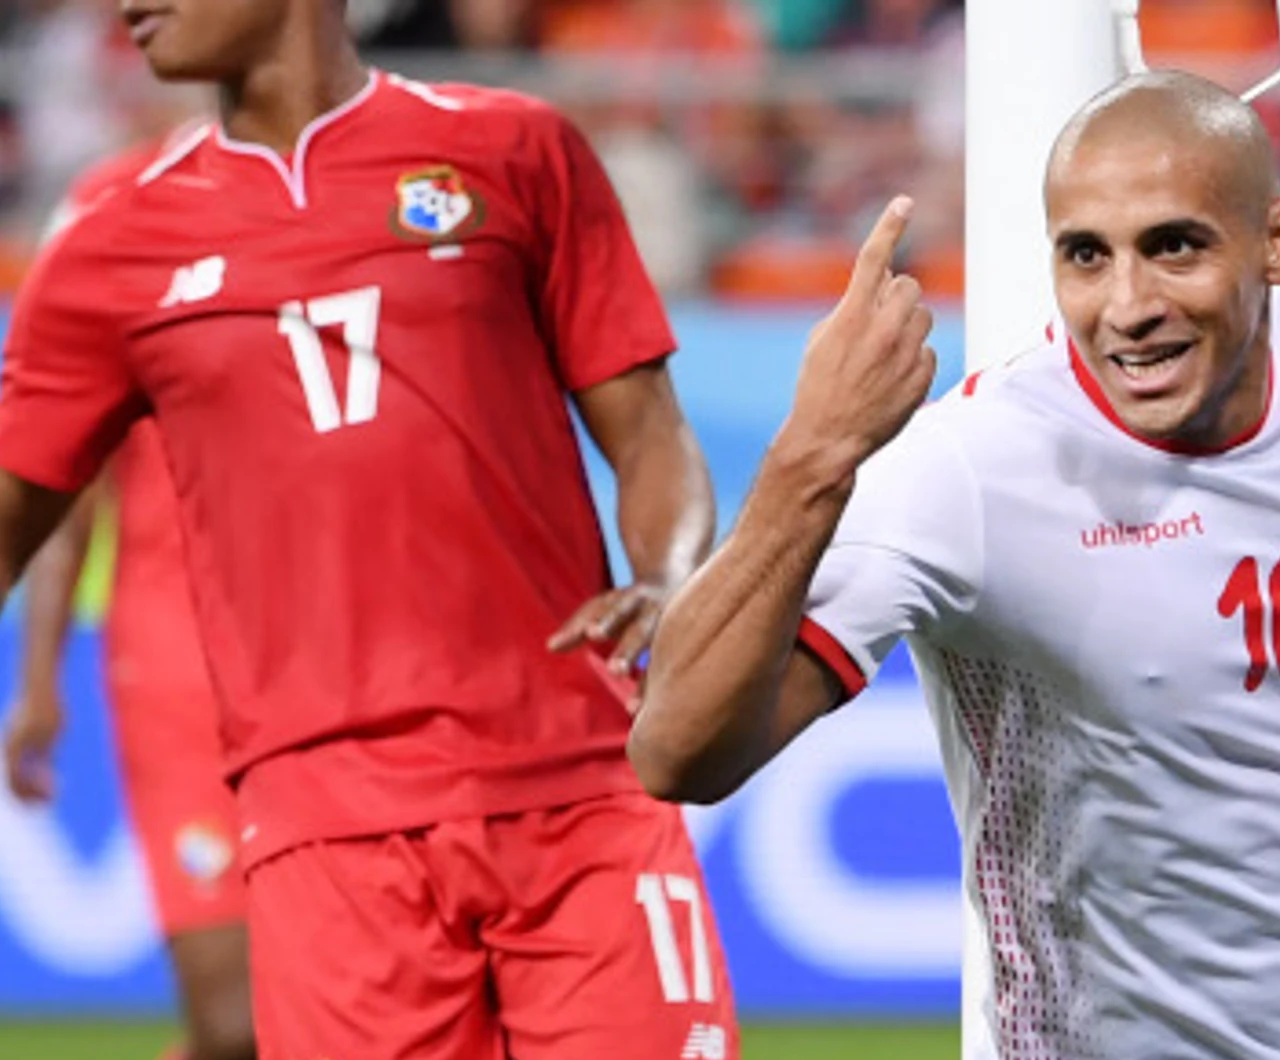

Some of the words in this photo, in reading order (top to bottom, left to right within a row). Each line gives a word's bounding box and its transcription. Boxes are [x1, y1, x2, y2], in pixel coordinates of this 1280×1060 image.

[277, 284, 381, 433] 17
[1081, 512, 1204, 549] uhlsport
[636, 873, 715, 1004] 17
